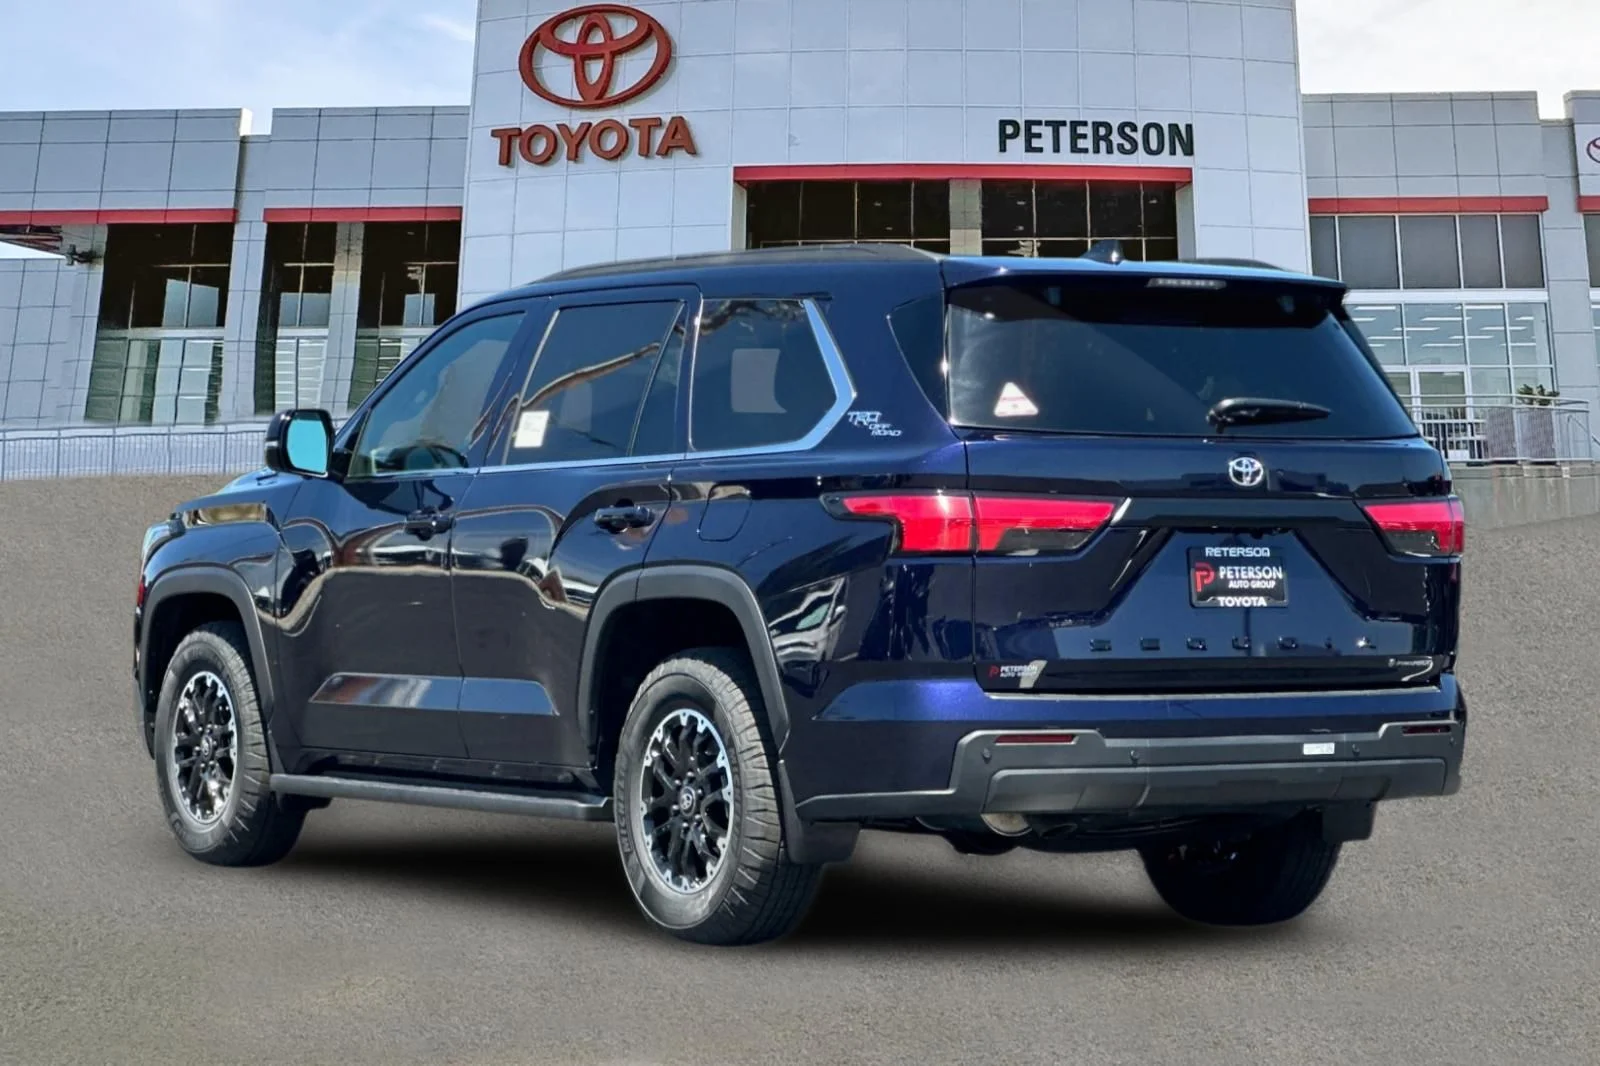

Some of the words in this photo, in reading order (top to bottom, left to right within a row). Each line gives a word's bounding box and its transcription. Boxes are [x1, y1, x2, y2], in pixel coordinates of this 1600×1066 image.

[491, 116, 697, 166] TOYOTA
[998, 119, 1194, 156] PETERSON
[847, 411, 882, 426] TRD
[1219, 566, 1283, 579] PETERSON
[1228, 580, 1249, 588] AUTO
[1250, 580, 1276, 589] GROUP
[1217, 597, 1267, 607] TOYOTA
